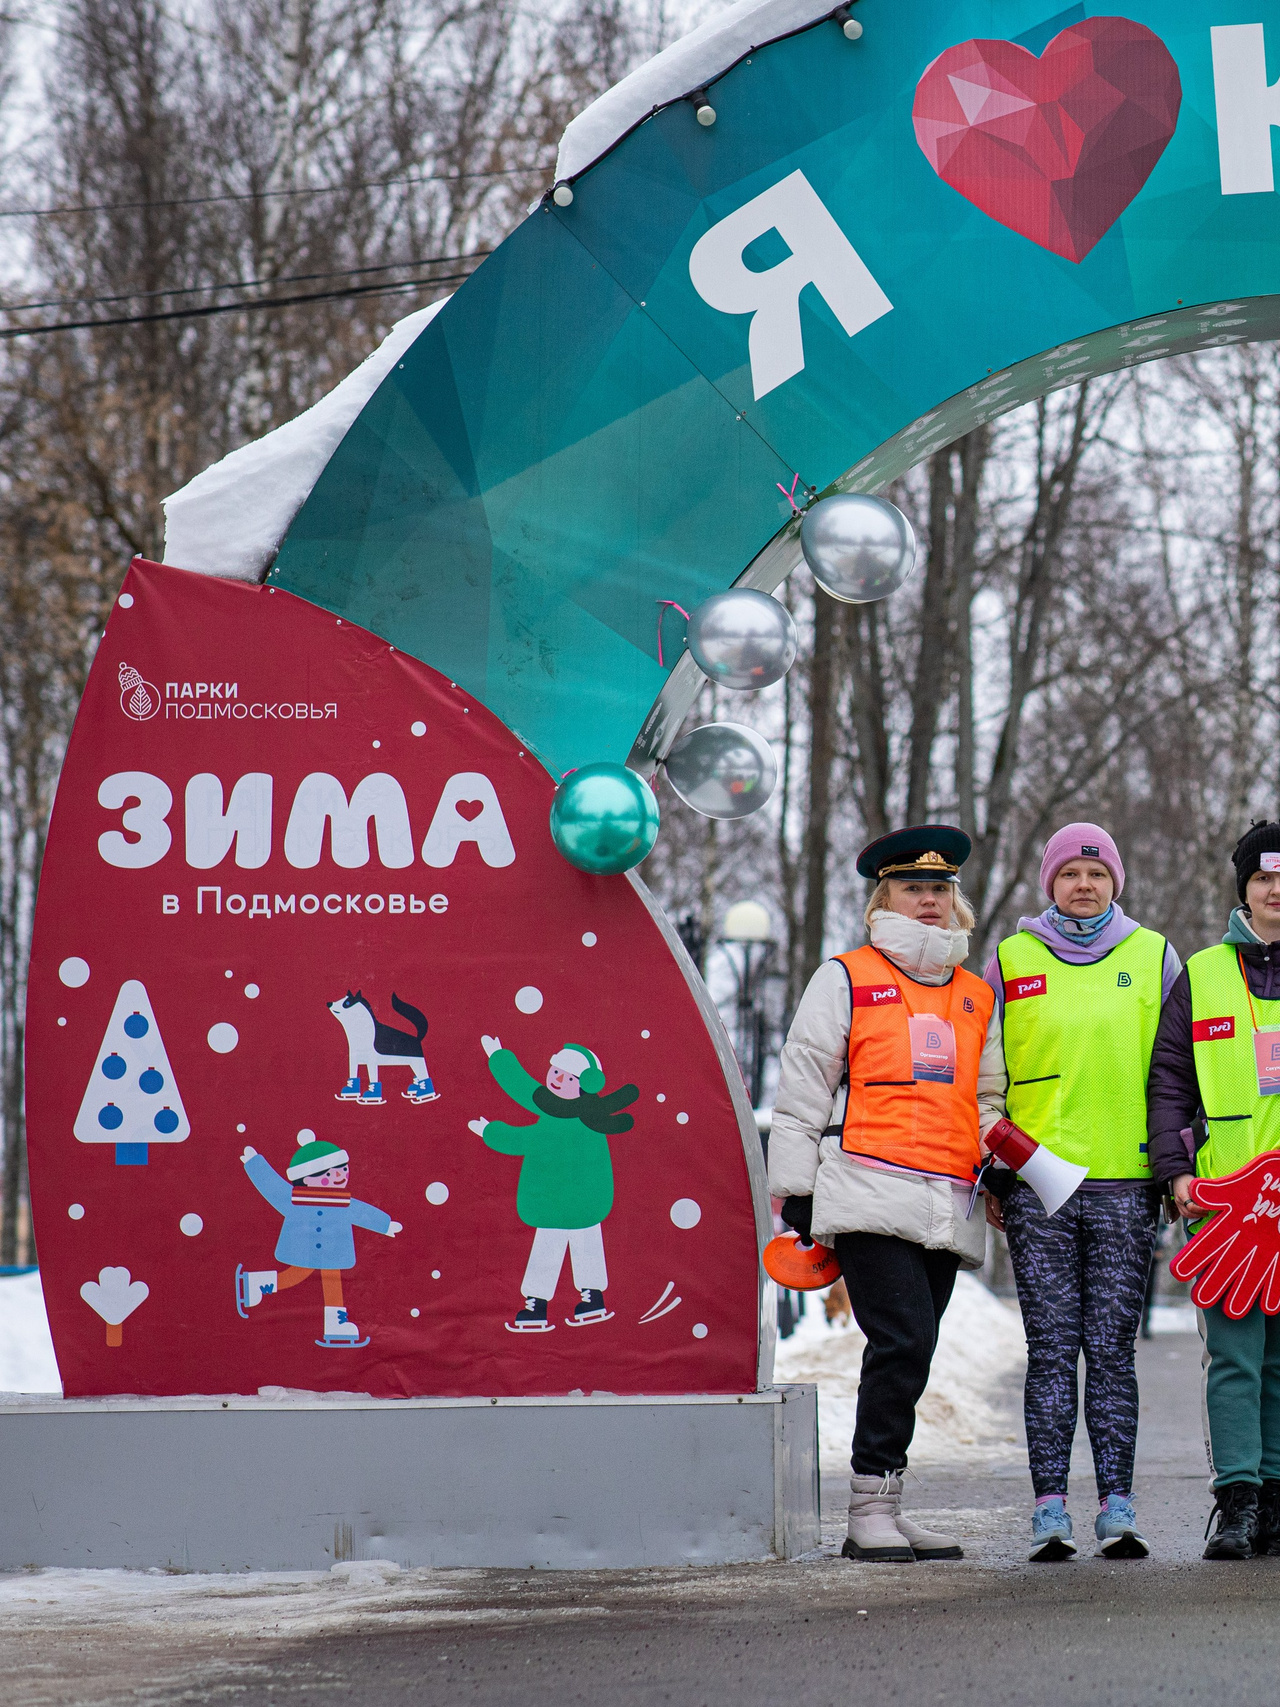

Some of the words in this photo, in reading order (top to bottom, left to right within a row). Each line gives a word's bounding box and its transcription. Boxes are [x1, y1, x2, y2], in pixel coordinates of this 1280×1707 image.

[690, 169, 893, 400] Я
[166, 683, 238, 698] ПАРКИ
[165, 703, 338, 719] ПОДМОСКОВЬЯ
[97, 771, 516, 869] ЗИМА
[162, 894, 180, 914] в
[197, 886, 449, 919] Подмосковье
